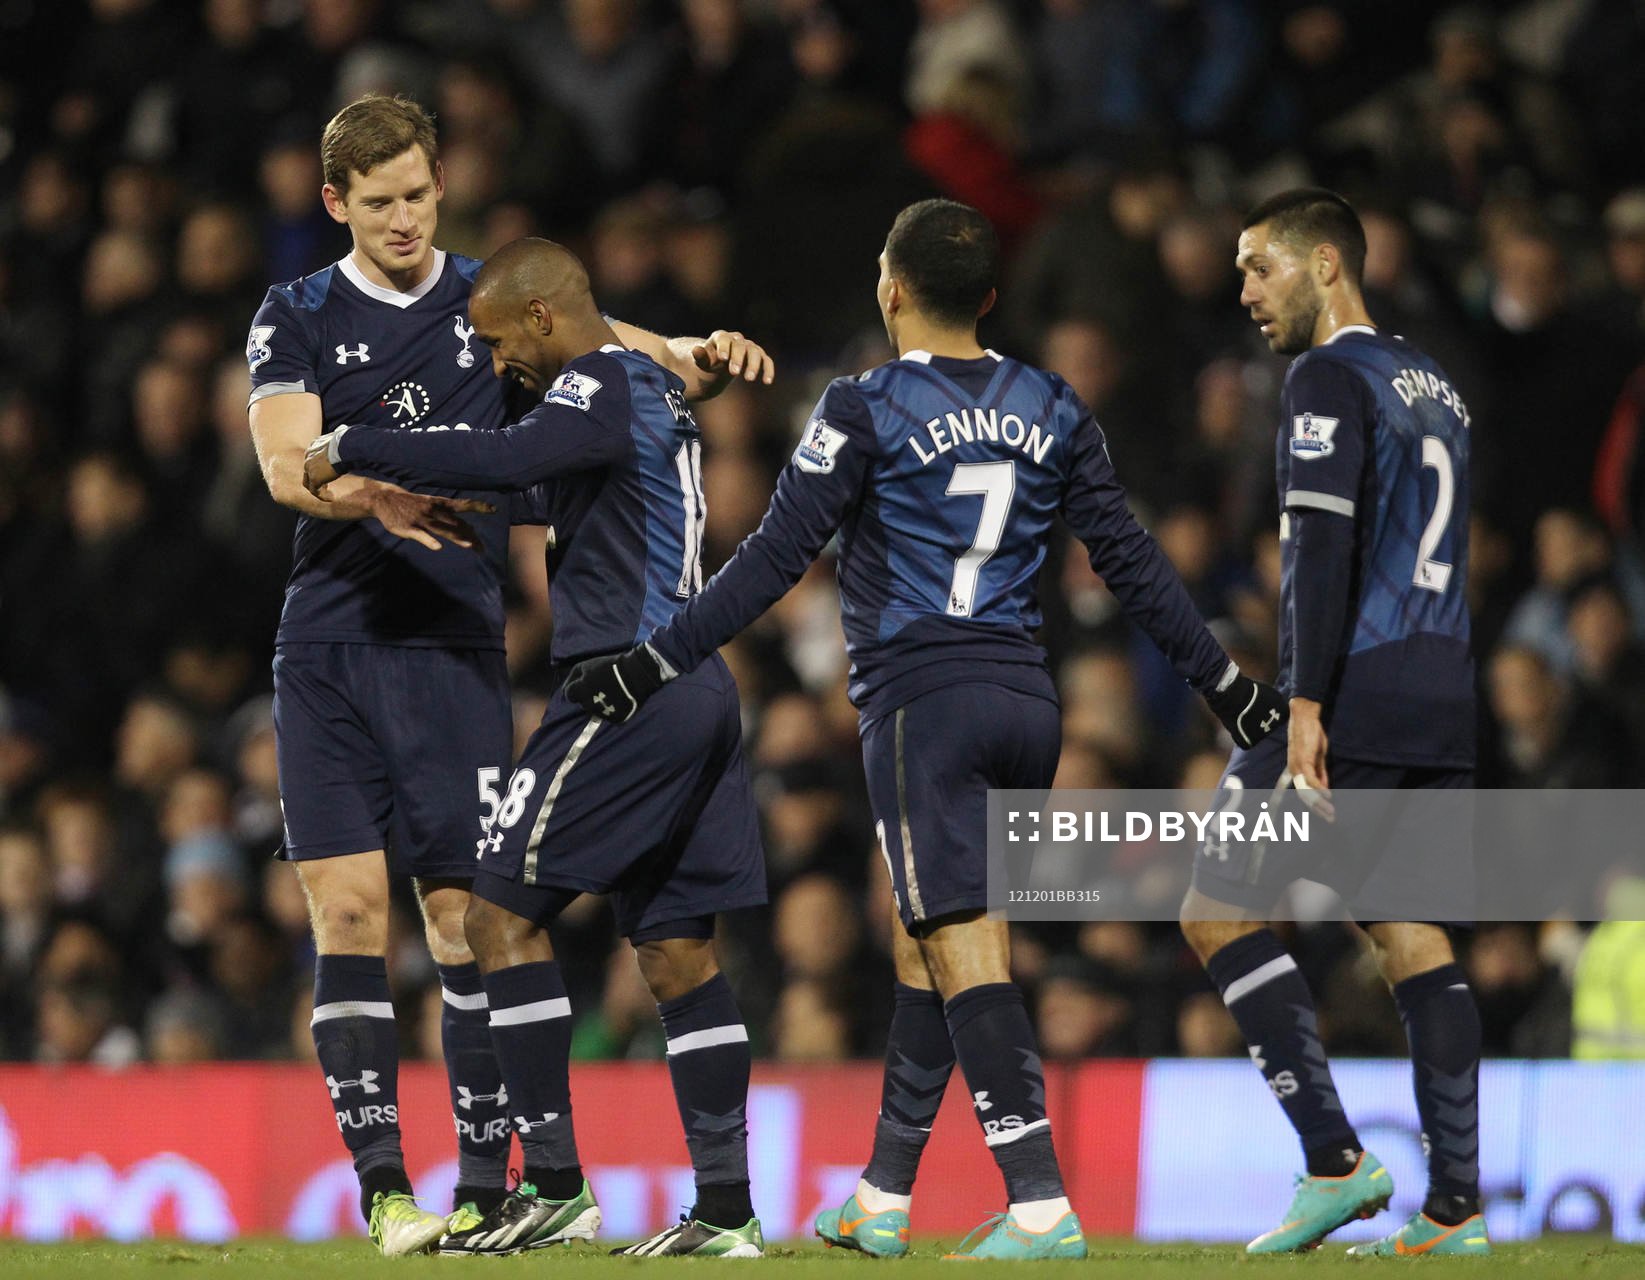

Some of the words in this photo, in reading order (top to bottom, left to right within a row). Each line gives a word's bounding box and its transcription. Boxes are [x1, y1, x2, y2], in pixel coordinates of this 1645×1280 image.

[908, 408, 1055, 466] LENNON
[944, 459, 1015, 617] 7
[1411, 435, 1454, 593] 2
[499, 767, 536, 829] 8
